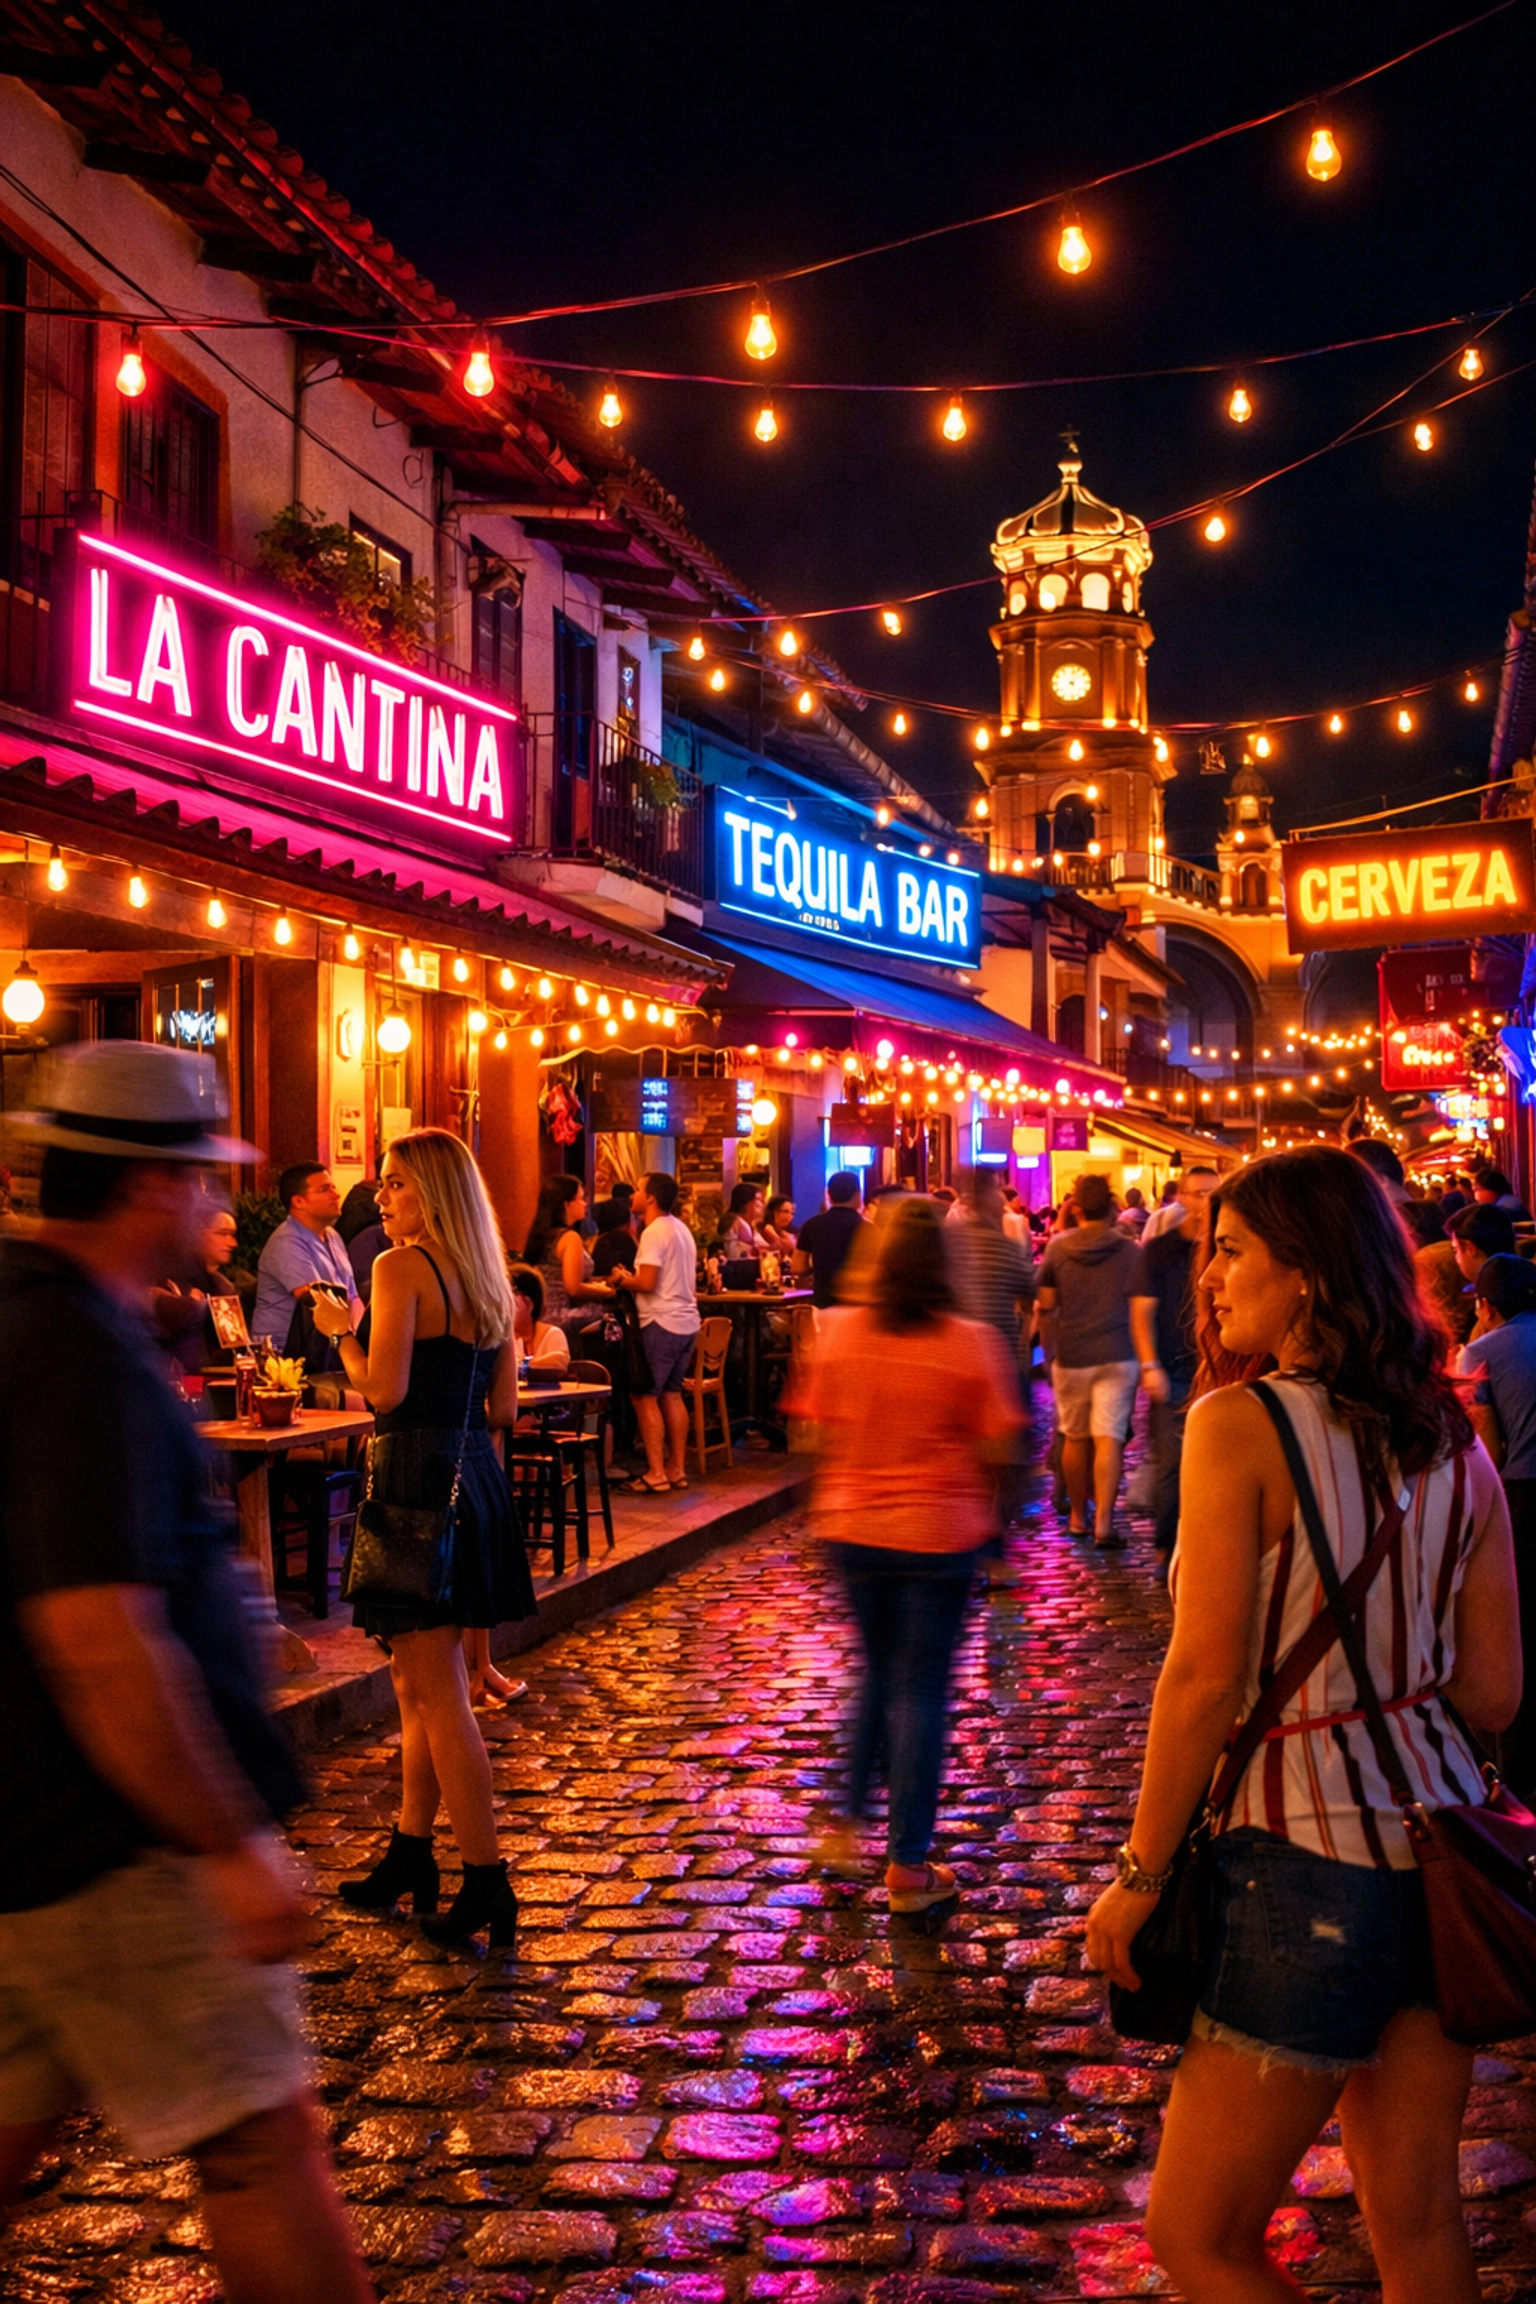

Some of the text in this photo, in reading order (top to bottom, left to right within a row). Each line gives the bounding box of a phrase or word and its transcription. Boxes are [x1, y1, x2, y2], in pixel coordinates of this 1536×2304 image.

[89, 567, 505, 819] LA CANTINA
[724, 811, 969, 947] TEQUILA BAR
[1299, 849, 1517, 925] CERVEZA
